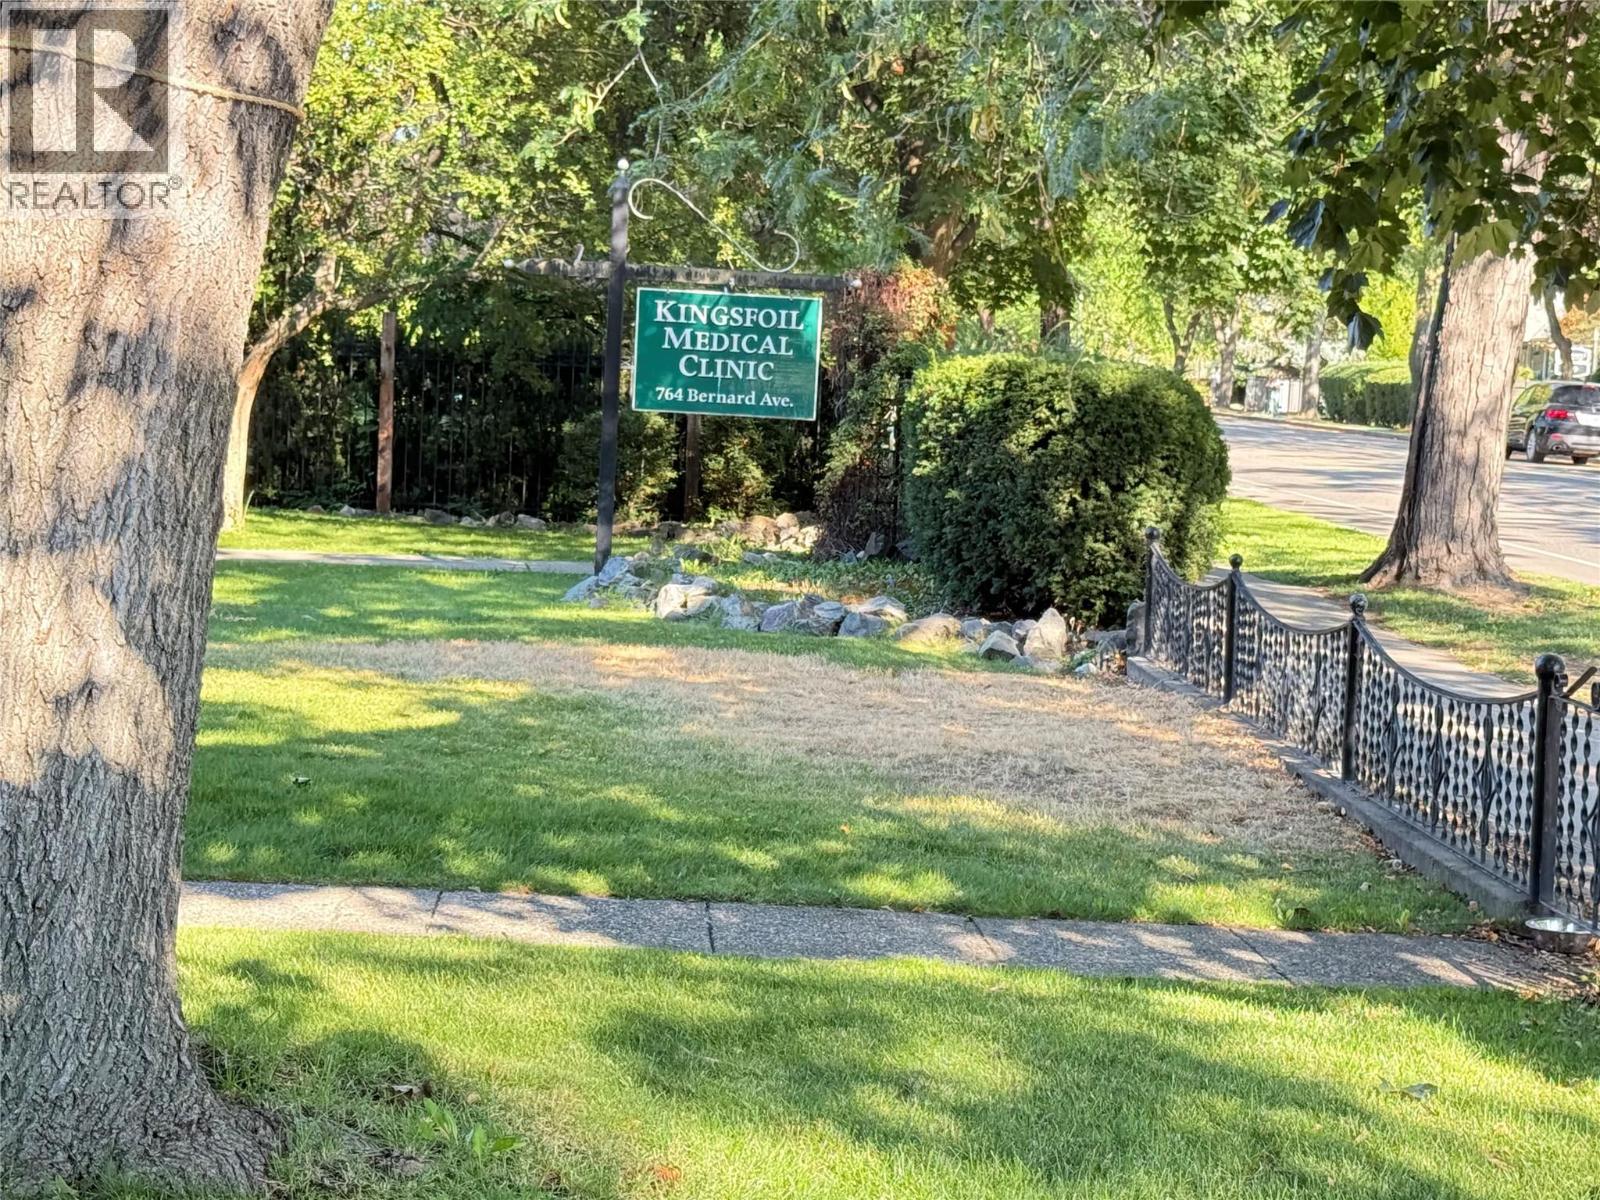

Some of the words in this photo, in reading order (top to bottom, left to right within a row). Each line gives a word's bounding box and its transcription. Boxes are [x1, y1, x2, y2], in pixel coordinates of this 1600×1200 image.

[654, 299, 805, 331] KINGSFOIL
[661, 326, 794, 356] MEDICAL
[678, 354, 775, 382] CLINIC
[655, 386, 684, 402] 764
[687, 388, 756, 406] Bernard
[759, 392, 795, 408] Ave.
